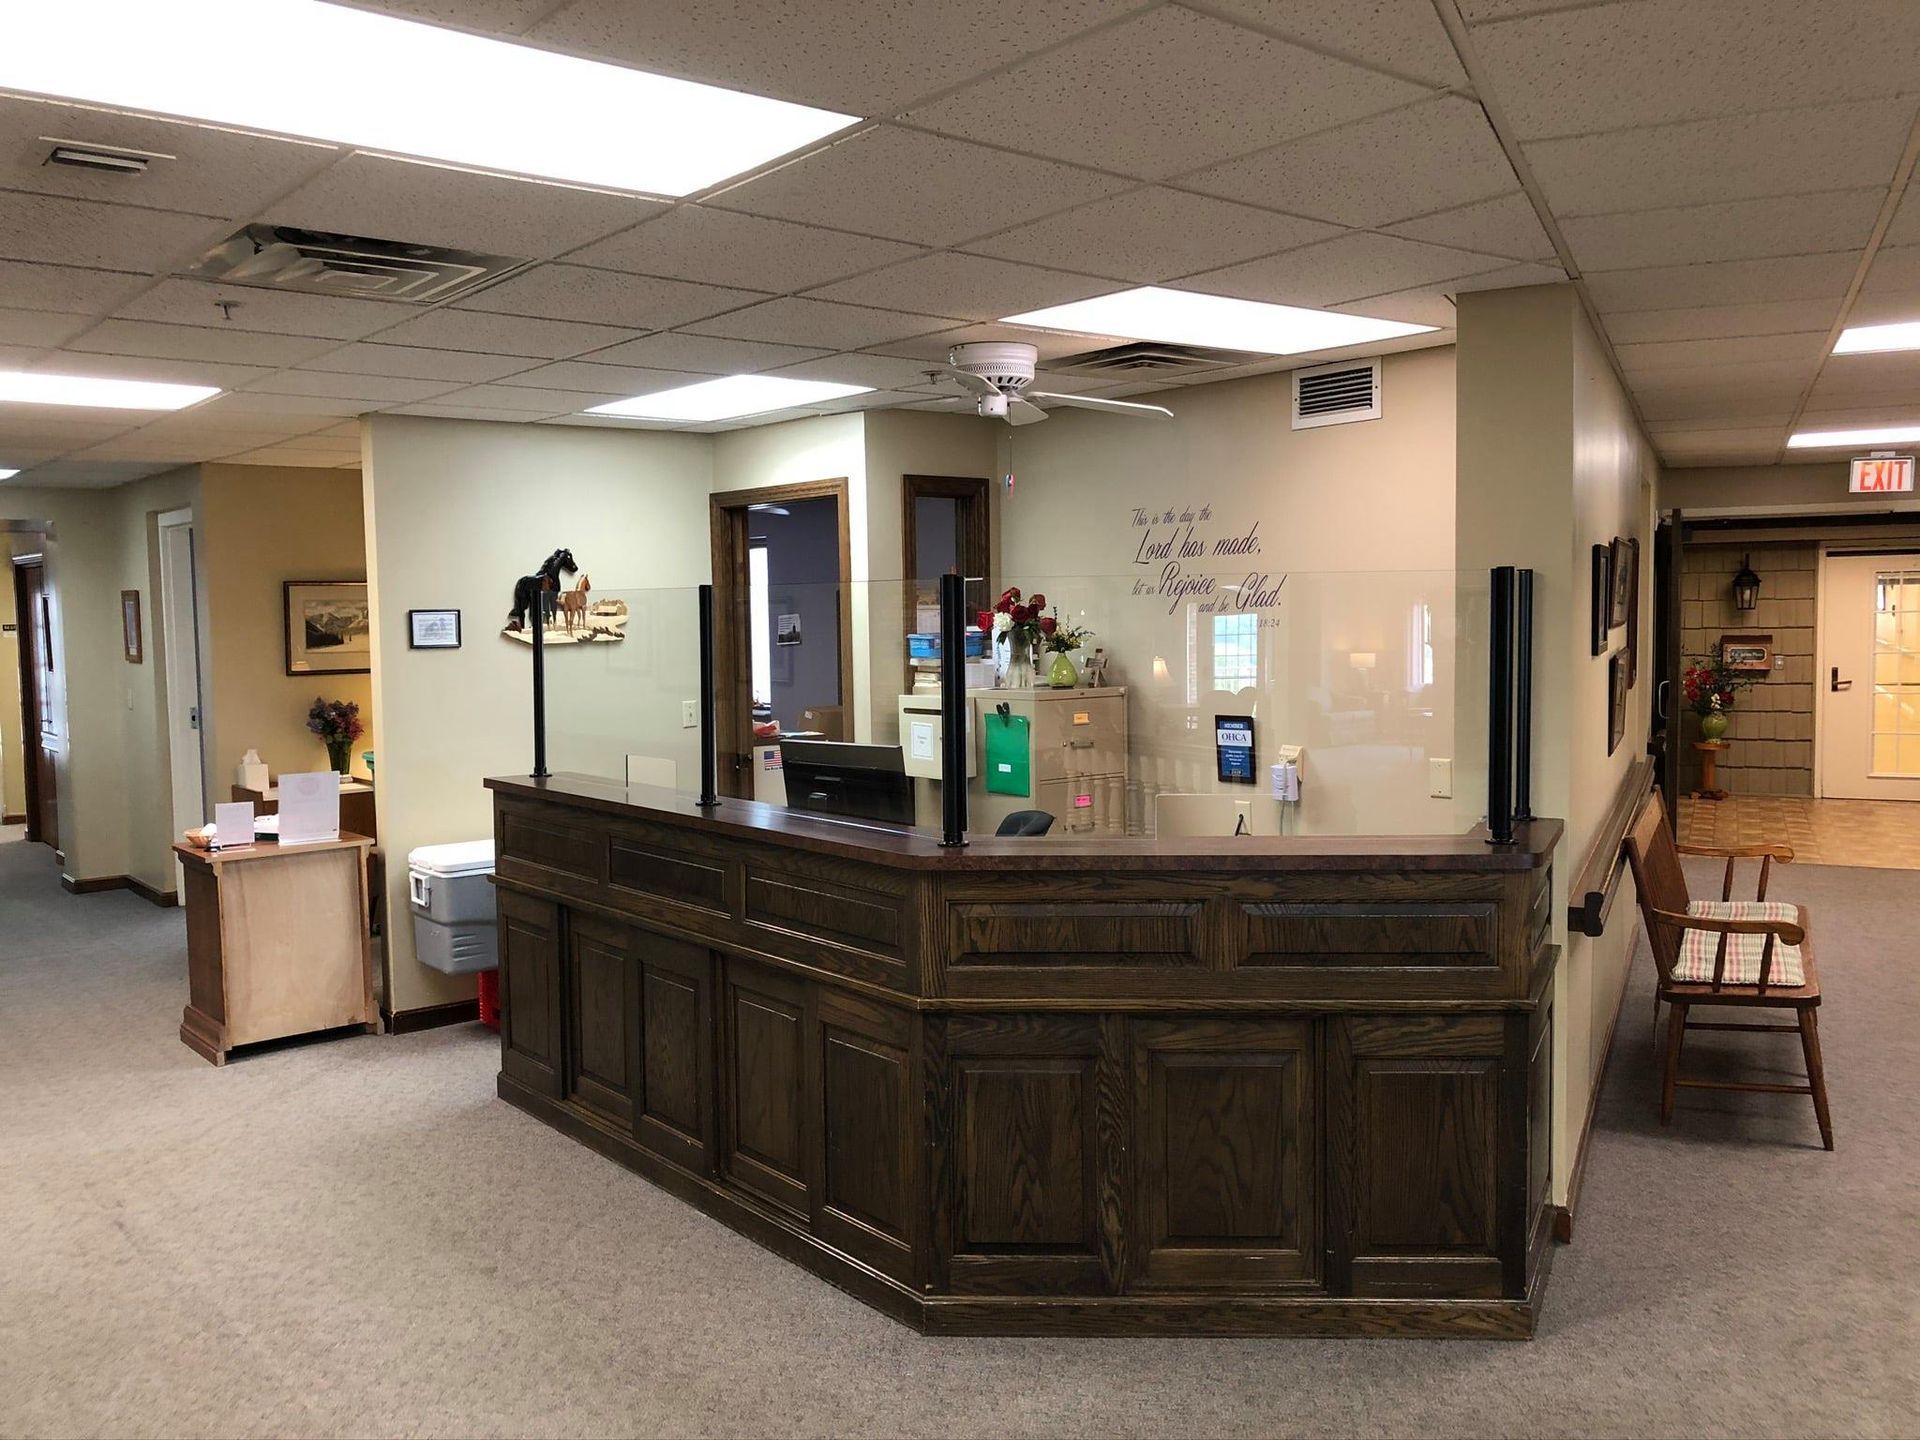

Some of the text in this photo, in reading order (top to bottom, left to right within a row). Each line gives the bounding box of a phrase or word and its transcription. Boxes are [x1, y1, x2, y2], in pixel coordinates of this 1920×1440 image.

[1860, 461, 1908, 491] EXIT
[1132, 503, 1213, 531] This is the day the
[1132, 527, 1179, 564] Lord
[1177, 526, 1206, 559] has
[1132, 560, 1217, 615] let us Rejoice
[1198, 572, 1288, 613] and be Glad.
[1221, 732, 1247, 742] OHCA
